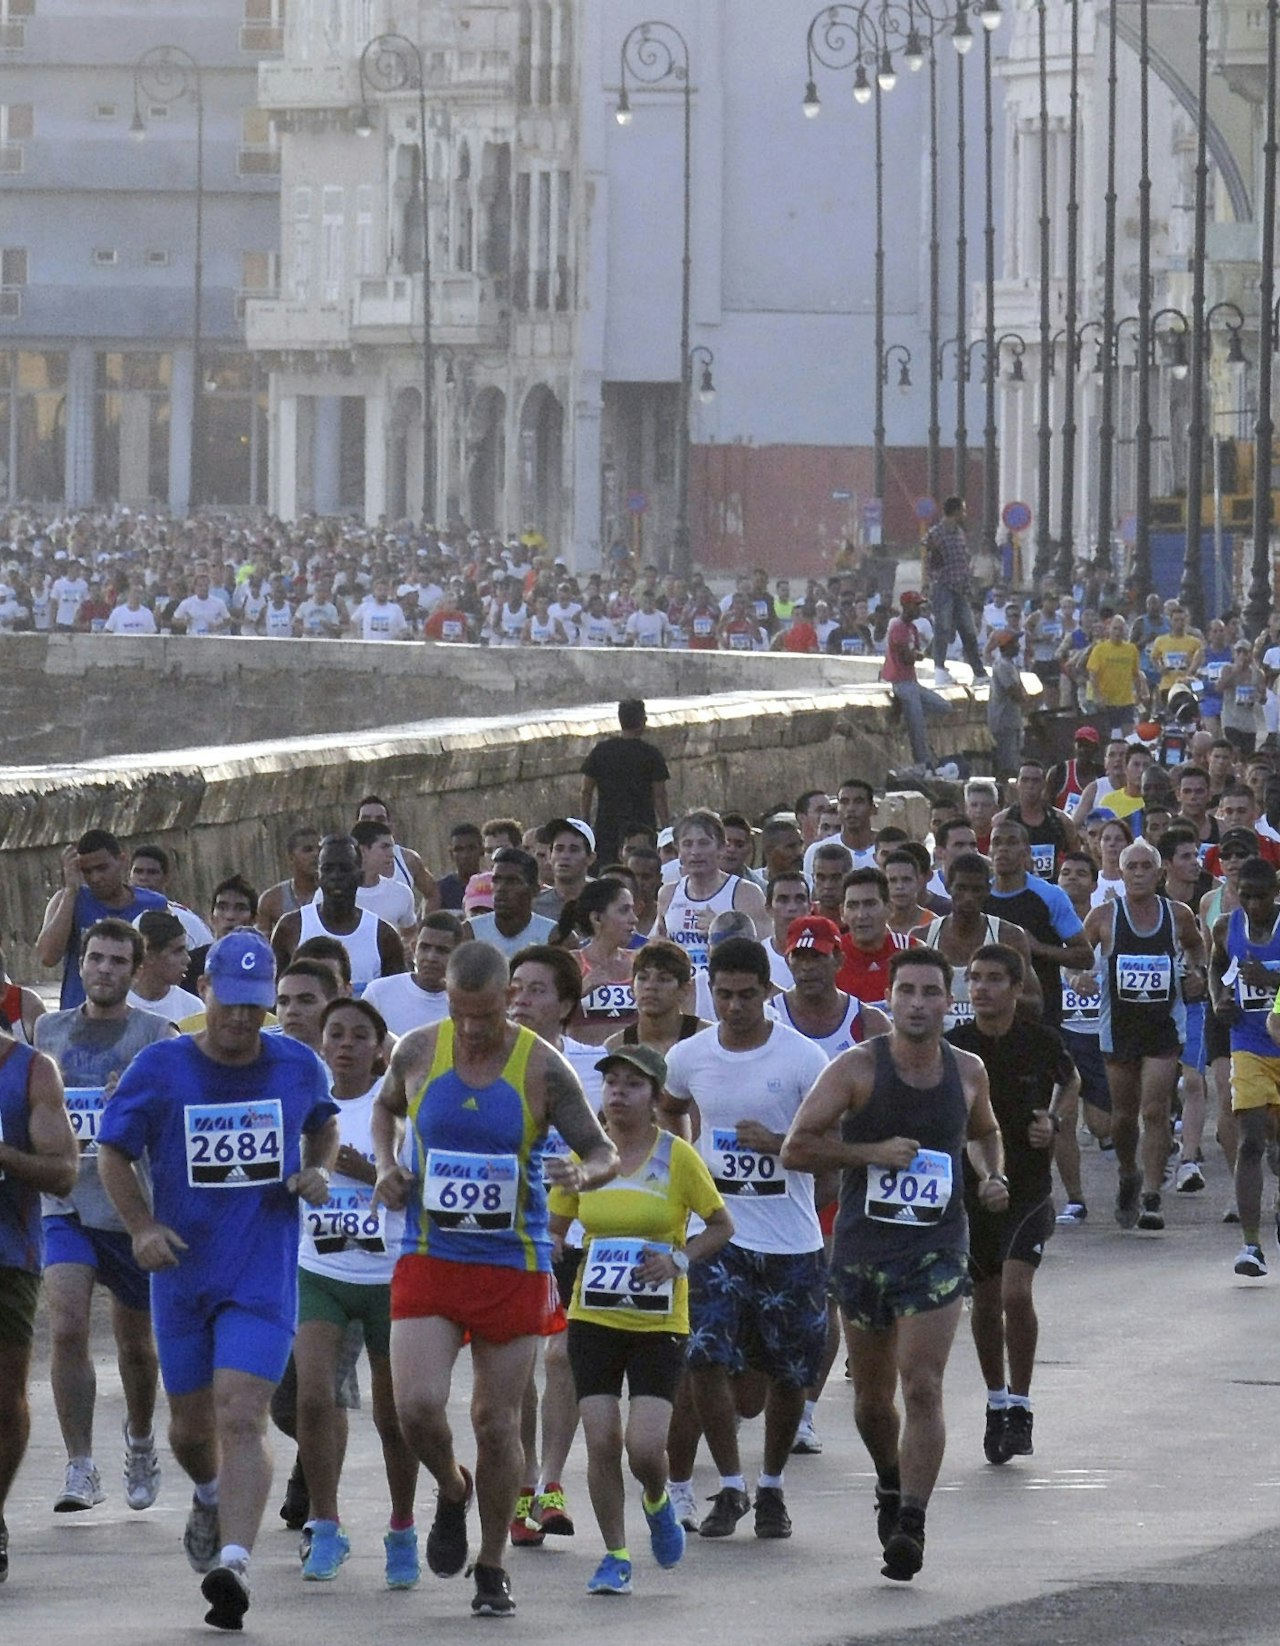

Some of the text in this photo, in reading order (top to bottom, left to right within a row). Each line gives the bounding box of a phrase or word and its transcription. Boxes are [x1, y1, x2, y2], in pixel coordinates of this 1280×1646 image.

[1126, 972, 1162, 989] 278
[190, 1131, 280, 1164] 2684
[722, 1153, 775, 1180] 390
[439, 1182, 502, 1211] 698
[879, 1173, 939, 1204] 904
